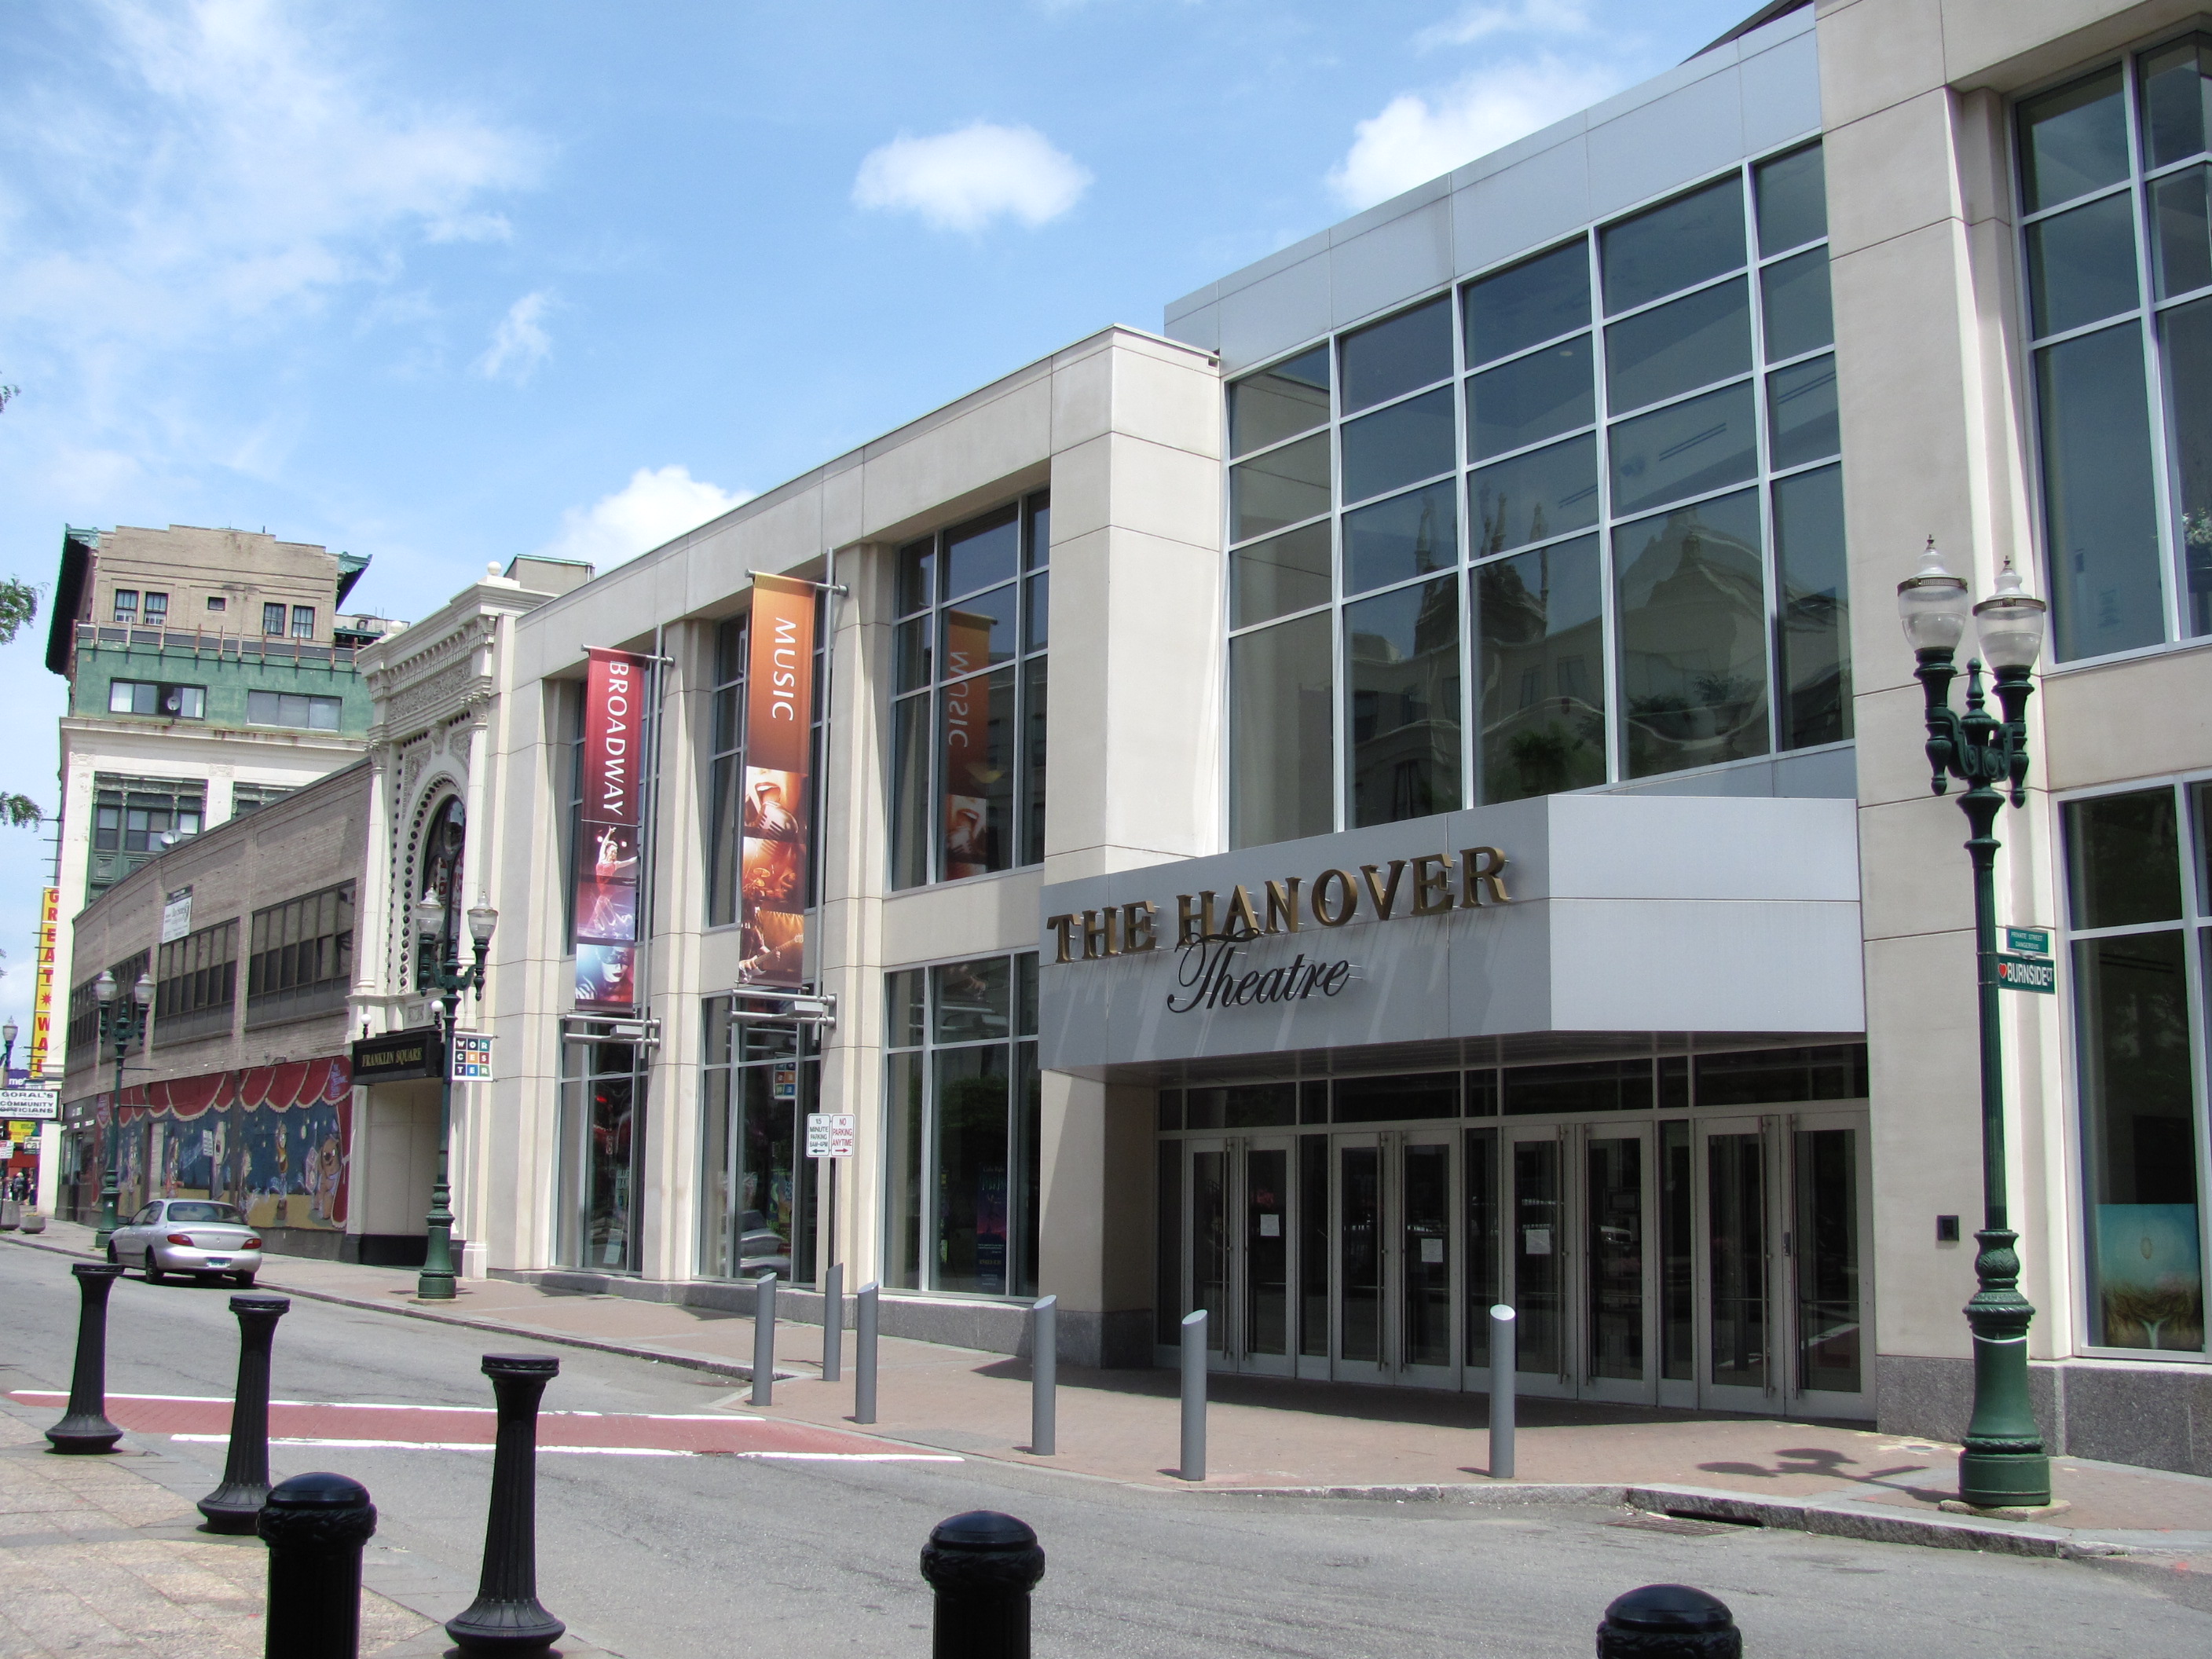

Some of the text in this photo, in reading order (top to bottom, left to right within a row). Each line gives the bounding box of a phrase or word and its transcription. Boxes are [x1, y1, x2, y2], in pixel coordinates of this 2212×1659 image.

[771, 617, 797, 721] MUSIC
[603, 661, 629, 816] BROADWAY
[43, 889, 60, 983] GREAT
[1046, 846, 1510, 963] THE HANOVER
[1166, 927, 1350, 1013] Theatre
[2007, 961, 2048, 987] BURNSIDE
[361, 1048, 422, 1068] FRANKLIN SQUARE
[832, 1138, 852, 1147] ANYTIME
